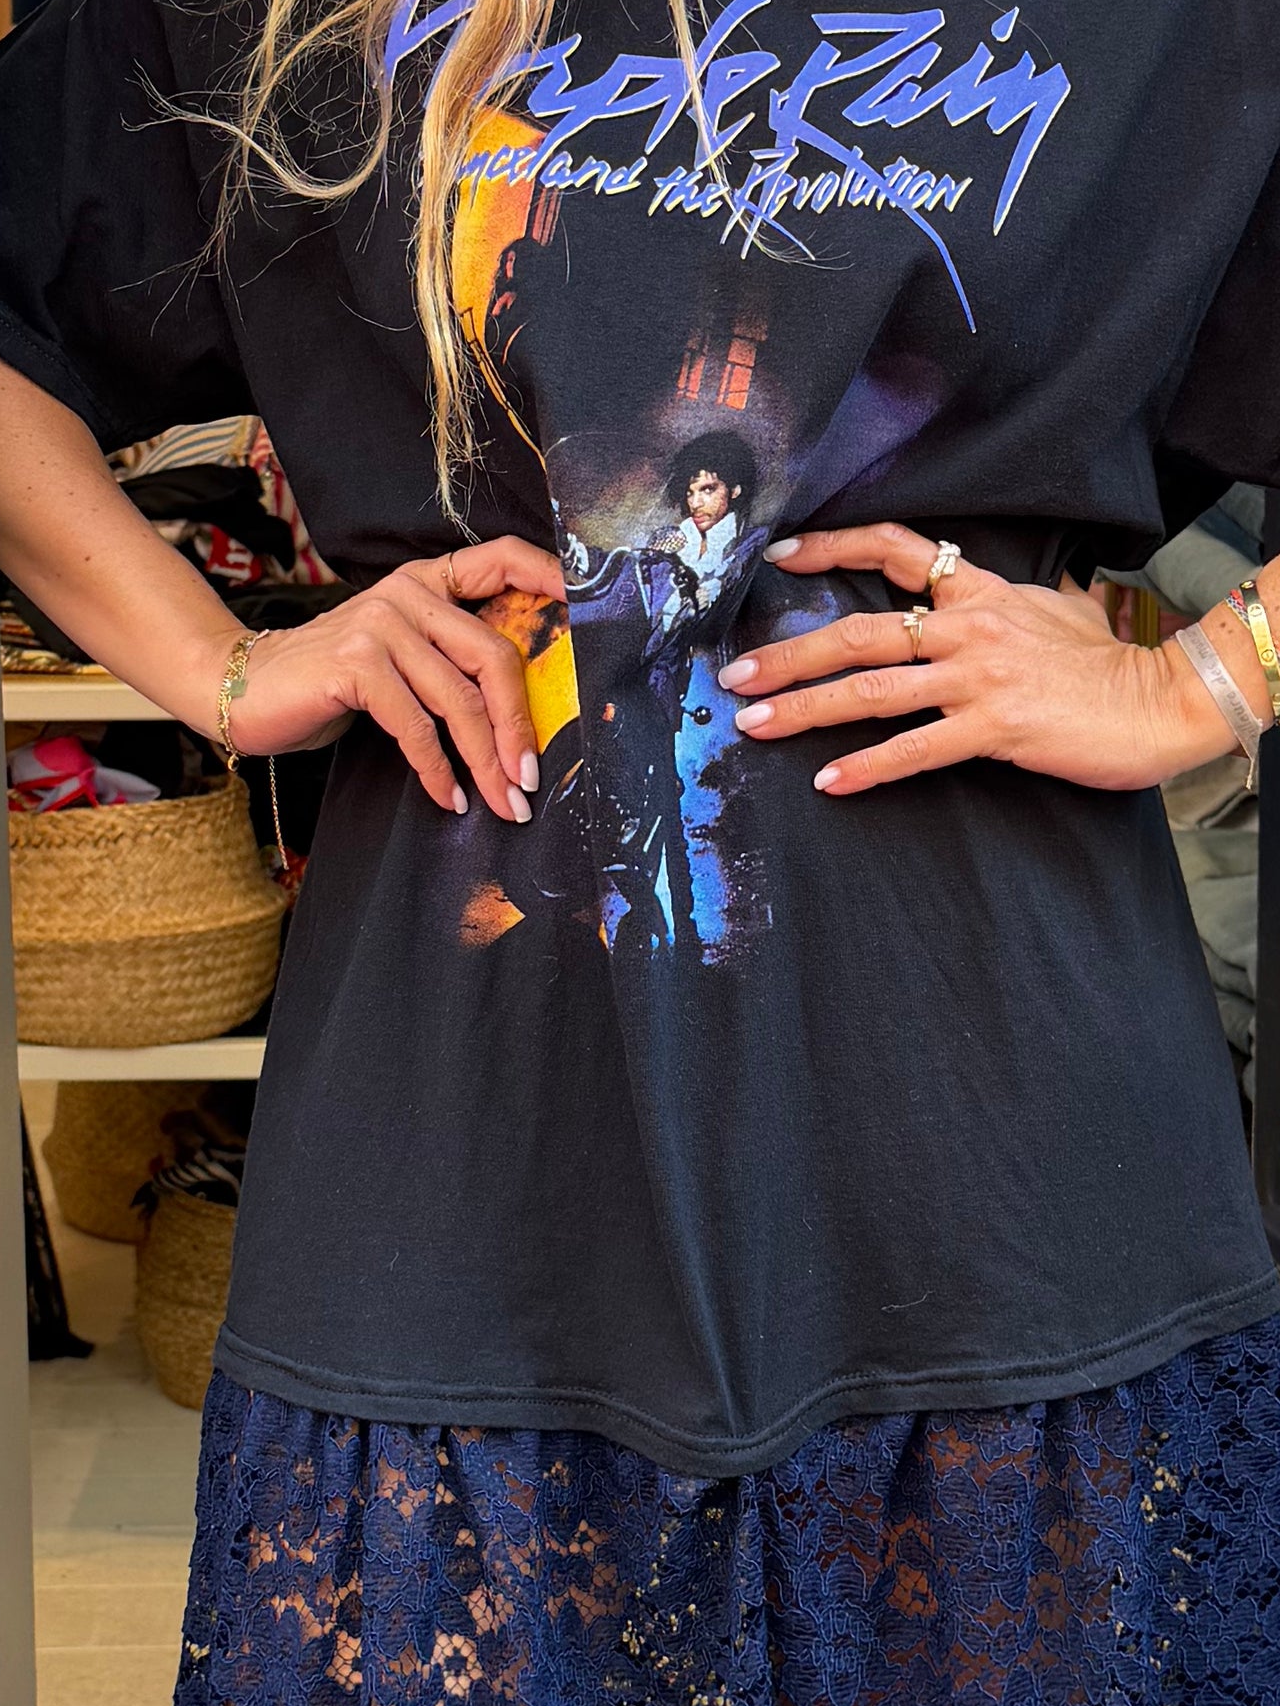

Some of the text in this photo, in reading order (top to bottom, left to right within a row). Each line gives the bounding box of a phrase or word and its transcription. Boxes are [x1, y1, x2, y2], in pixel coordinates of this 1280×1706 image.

[648, 165, 729, 218] the
[719, 145, 973, 259] Revolution
[769, 6, 1071, 333] Rain
